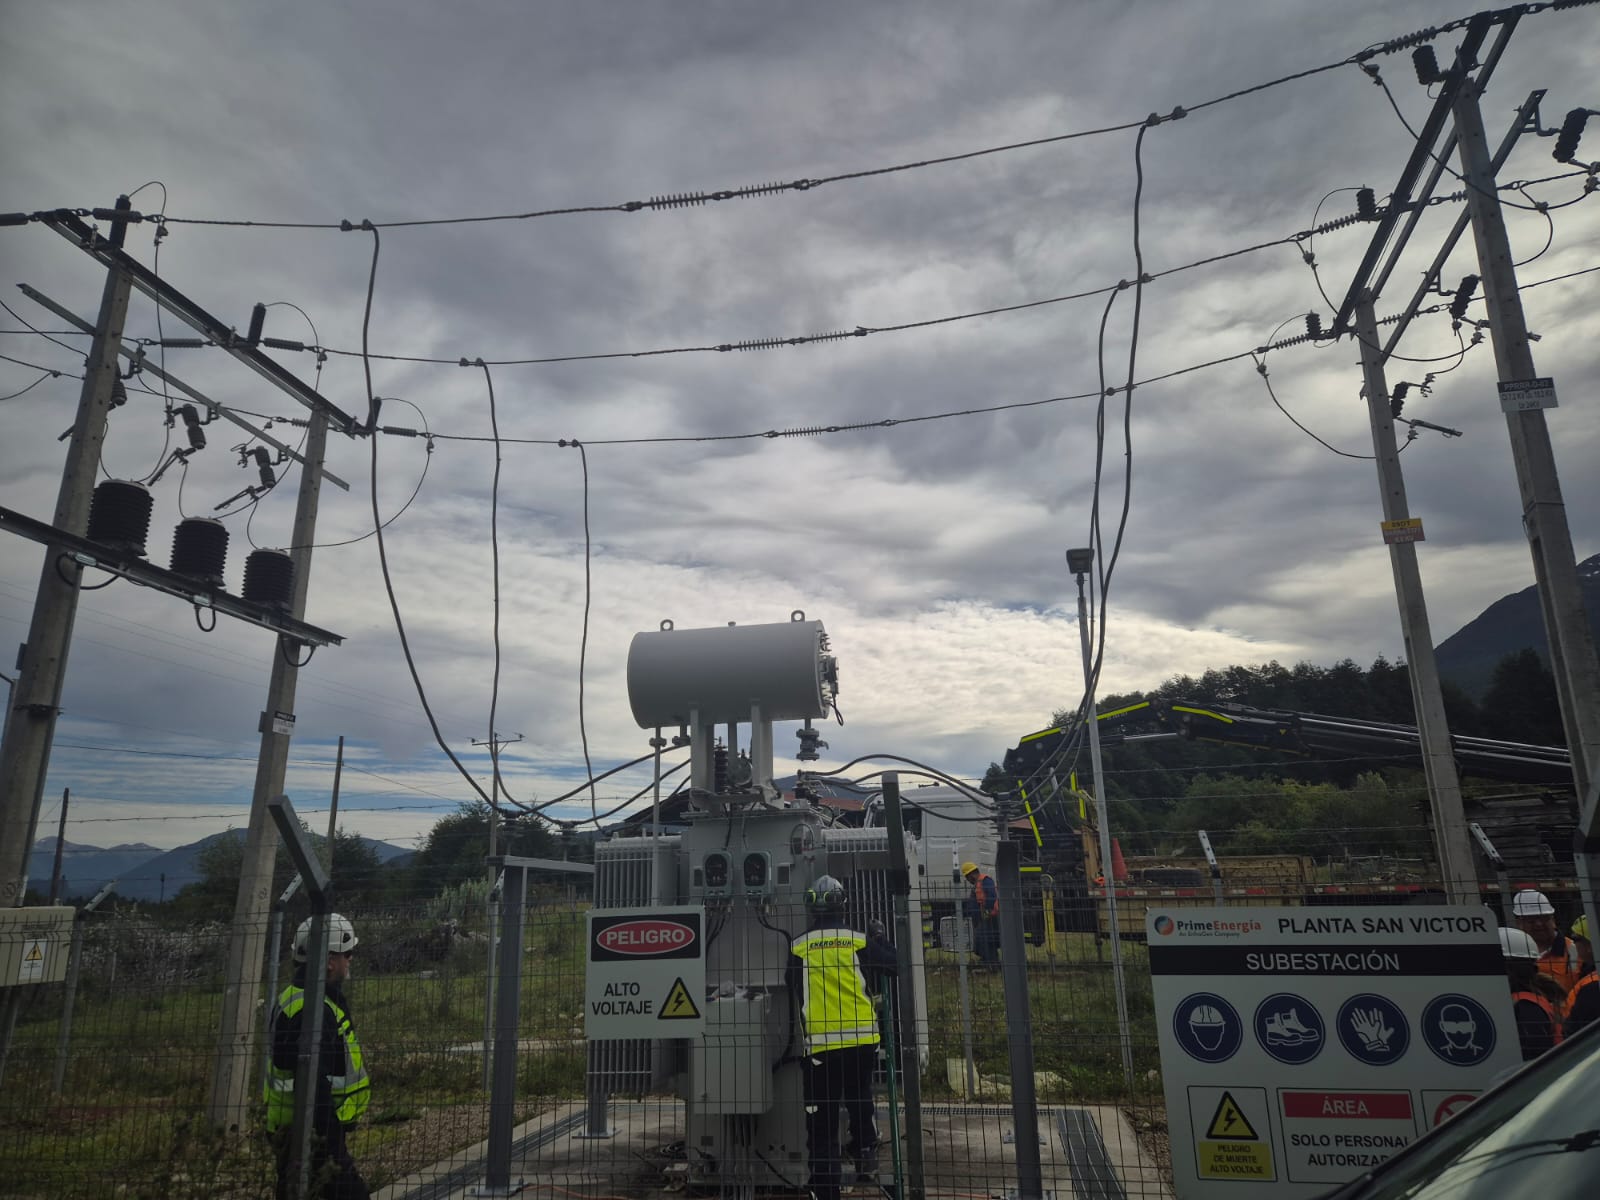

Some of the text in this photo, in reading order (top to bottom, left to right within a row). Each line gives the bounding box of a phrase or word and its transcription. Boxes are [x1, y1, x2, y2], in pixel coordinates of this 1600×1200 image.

[1279, 917, 1487, 933] PLANTA SAN VICTOR
[606, 929, 685, 945] PELIGRO
[1246, 950, 1400, 970] SUBESTACIÓN
[604, 982, 640, 997] ALTO
[592, 1000, 652, 1015] VOLTAJE
[1322, 1096, 1369, 1114] ÁREA
[1218, 1144, 1251, 1152] PELIGRO
[1291, 1135, 1330, 1146] SOLO
[1214, 1154, 1257, 1163] DE MUERTE
[1307, 1153, 1389, 1166] AUTORIZA
[1210, 1164, 1264, 1174] ALTO VOLTAJE
